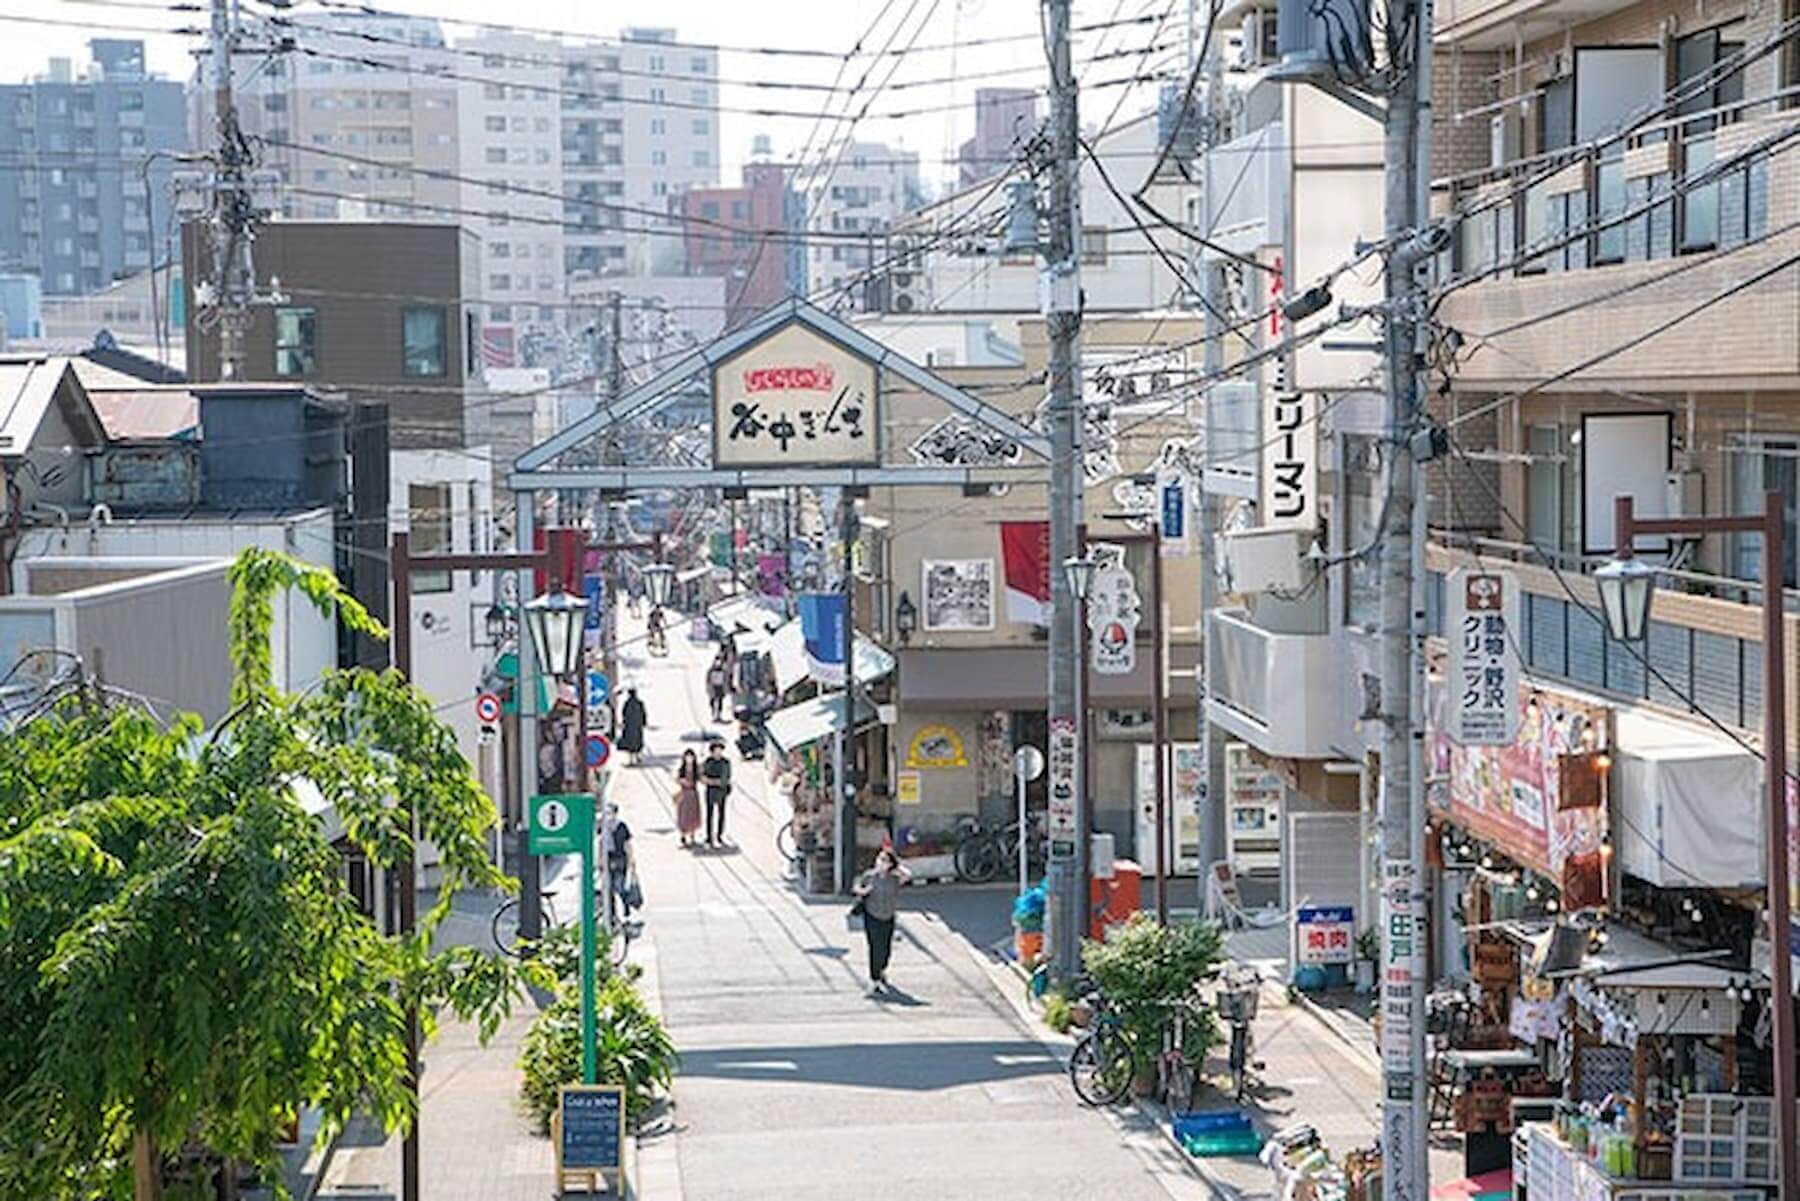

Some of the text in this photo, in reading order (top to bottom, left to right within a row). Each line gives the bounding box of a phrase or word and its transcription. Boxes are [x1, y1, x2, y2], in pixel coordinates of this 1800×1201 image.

[729, 386, 865, 452] 谷中ぎんざ
[1463, 615, 1482, 708] クリニック
[1308, 930, 1347, 950] 焼肉
